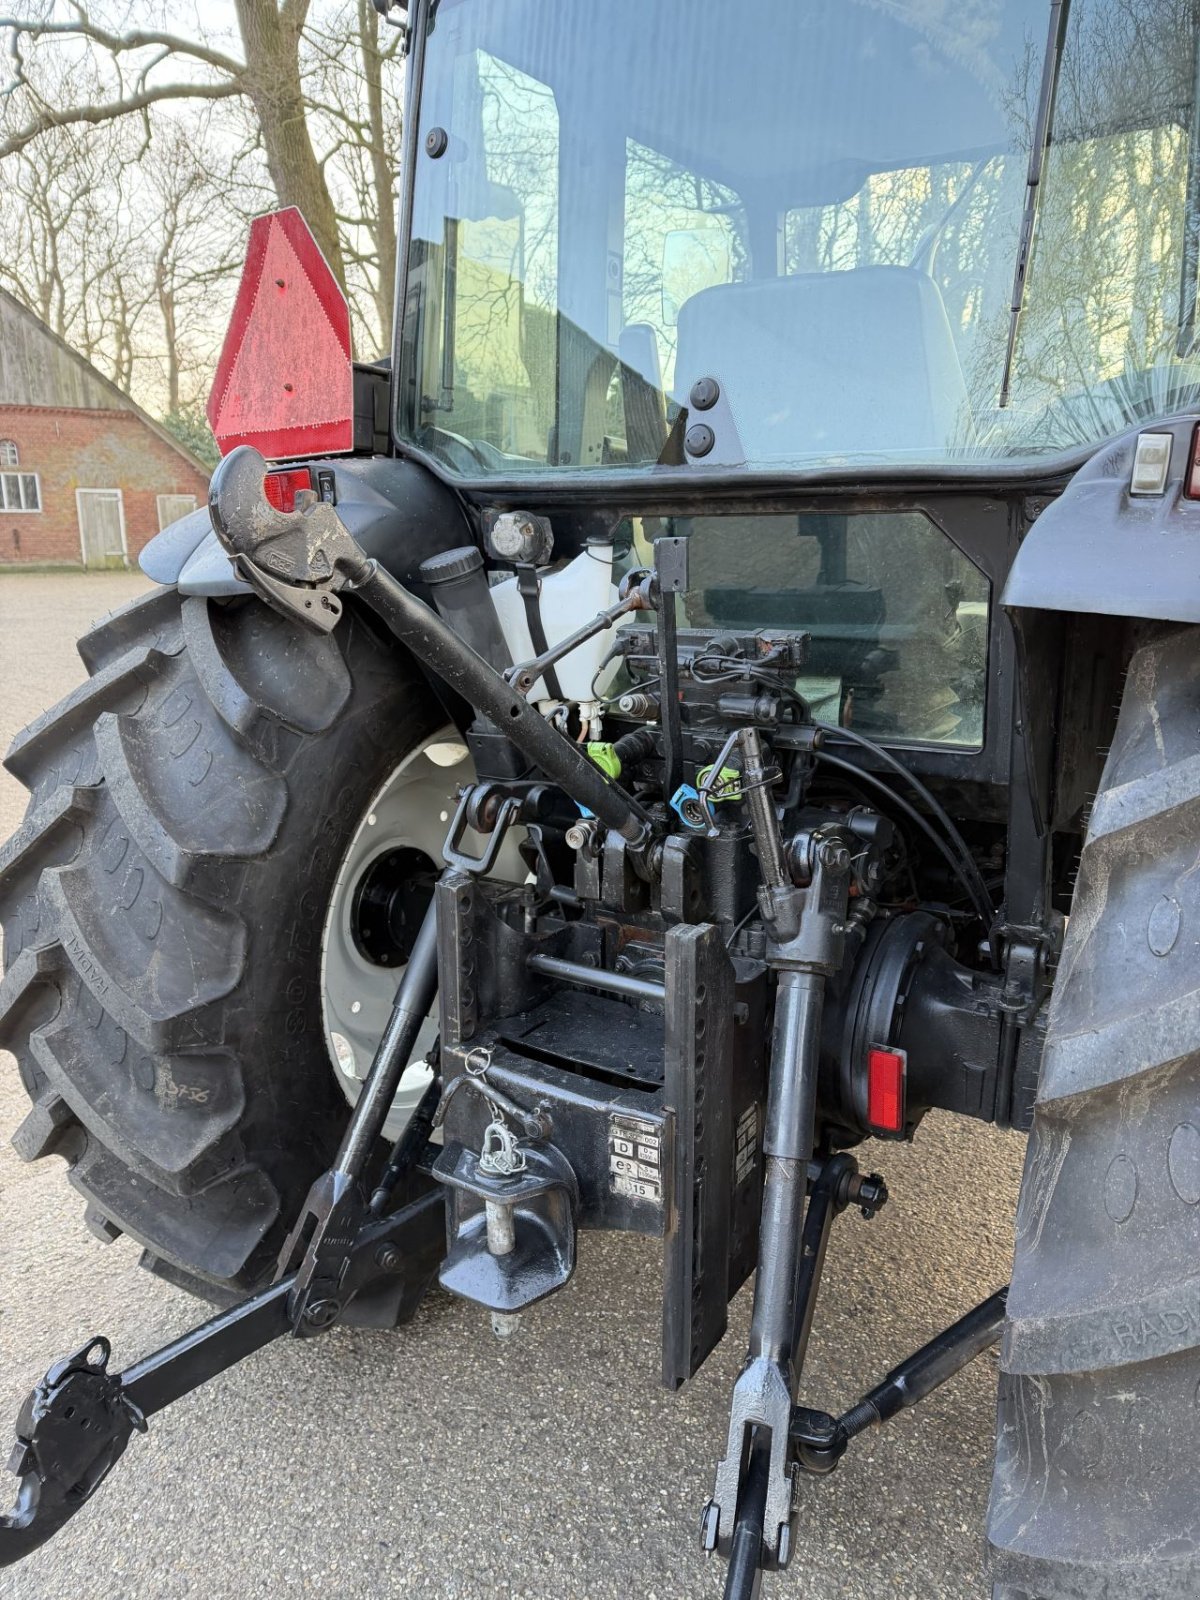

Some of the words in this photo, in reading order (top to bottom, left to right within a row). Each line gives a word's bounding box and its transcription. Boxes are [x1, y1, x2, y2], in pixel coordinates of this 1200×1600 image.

[67, 928, 109, 996] RADIAL
[620, 1143, 628, 1153] D
[616, 1160, 632, 1174] e2
